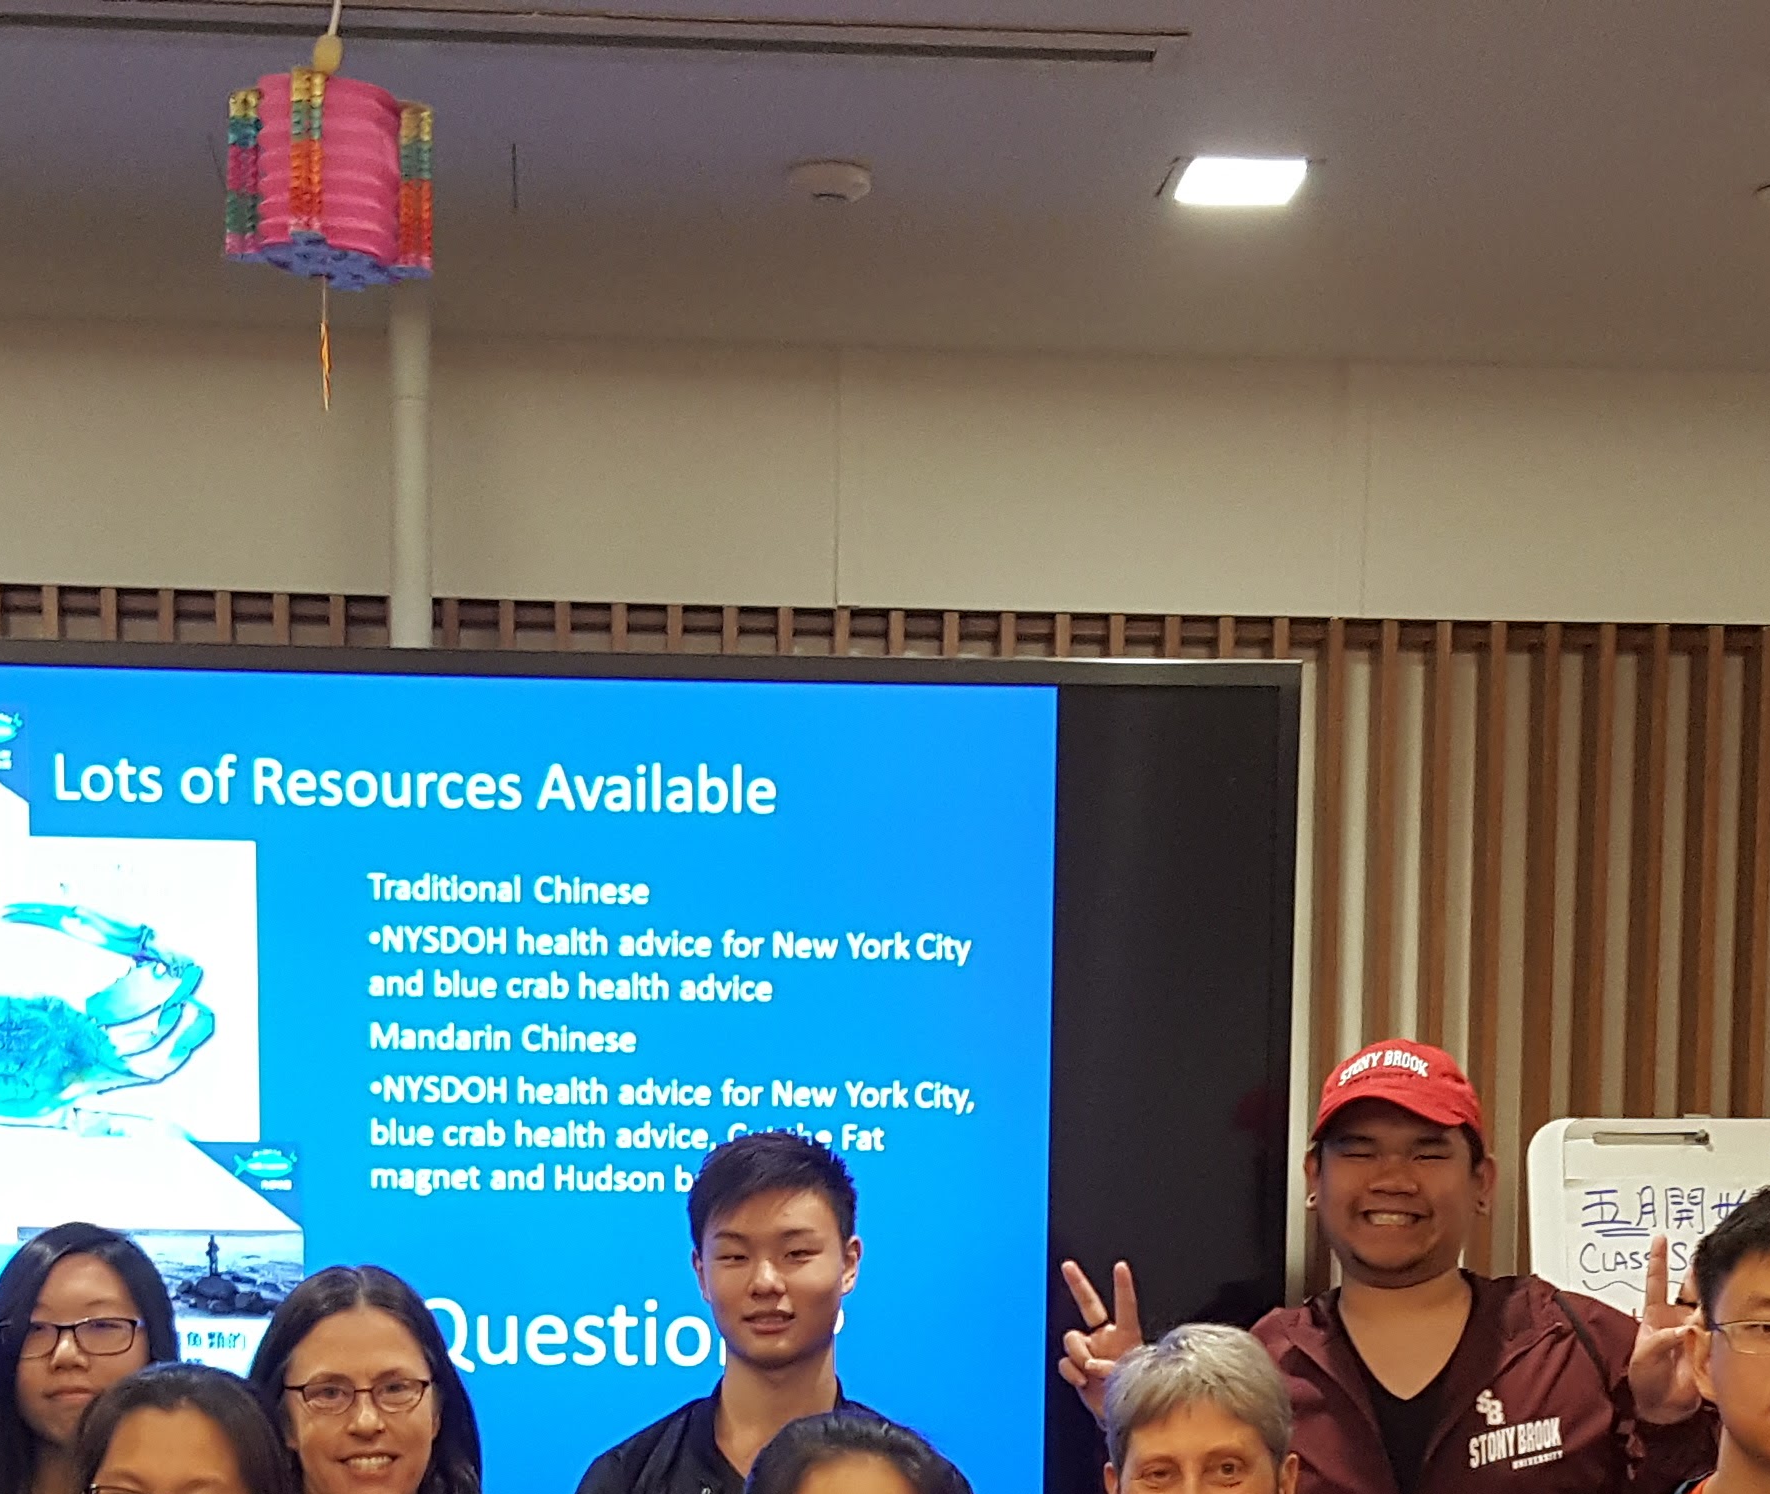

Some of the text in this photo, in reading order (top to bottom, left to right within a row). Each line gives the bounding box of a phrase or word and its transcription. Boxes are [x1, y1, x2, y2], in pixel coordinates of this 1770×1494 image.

[55, 753, 777, 814] Lots of Resources Available
[367, 872, 650, 905] Traditional Chinese
[517, 927, 608, 956] health
[619, 929, 712, 957] advice
[722, 929, 765, 958] for
[772, 931, 839, 959] New
[846, 932, 911, 960] York
[916, 932, 972, 967] City
[368, 969, 773, 1002] and blue crab health advice
[370, 1022, 637, 1053] Mandarin Chinese
[1338, 1050, 1429, 1087] STONY BROOK
[517, 1076, 608, 1105] health
[618, 1078, 712, 1107] advice
[722, 1078, 764, 1107] for
[772, 1079, 837, 1108] New
[845, 1080, 909, 1108] York
[914, 1081, 975, 1115] City,
[370, 1118, 434, 1147] blue
[443, 1119, 506, 1147] crab
[515, 1119, 606, 1149] health
[616, 1121, 717, 1151] advice,
[841, 1123, 885, 1151] Fat
[370, 1165, 481, 1196] magnet
[490, 1163, 545, 1191] and
[554, 1164, 665, 1192] Hudson
[1475, 1389, 1506, 1425] SB
[1468, 1417, 1562, 1469] STONY BROOK
[1511, 1450, 1563, 1470] UNIVERSITY
